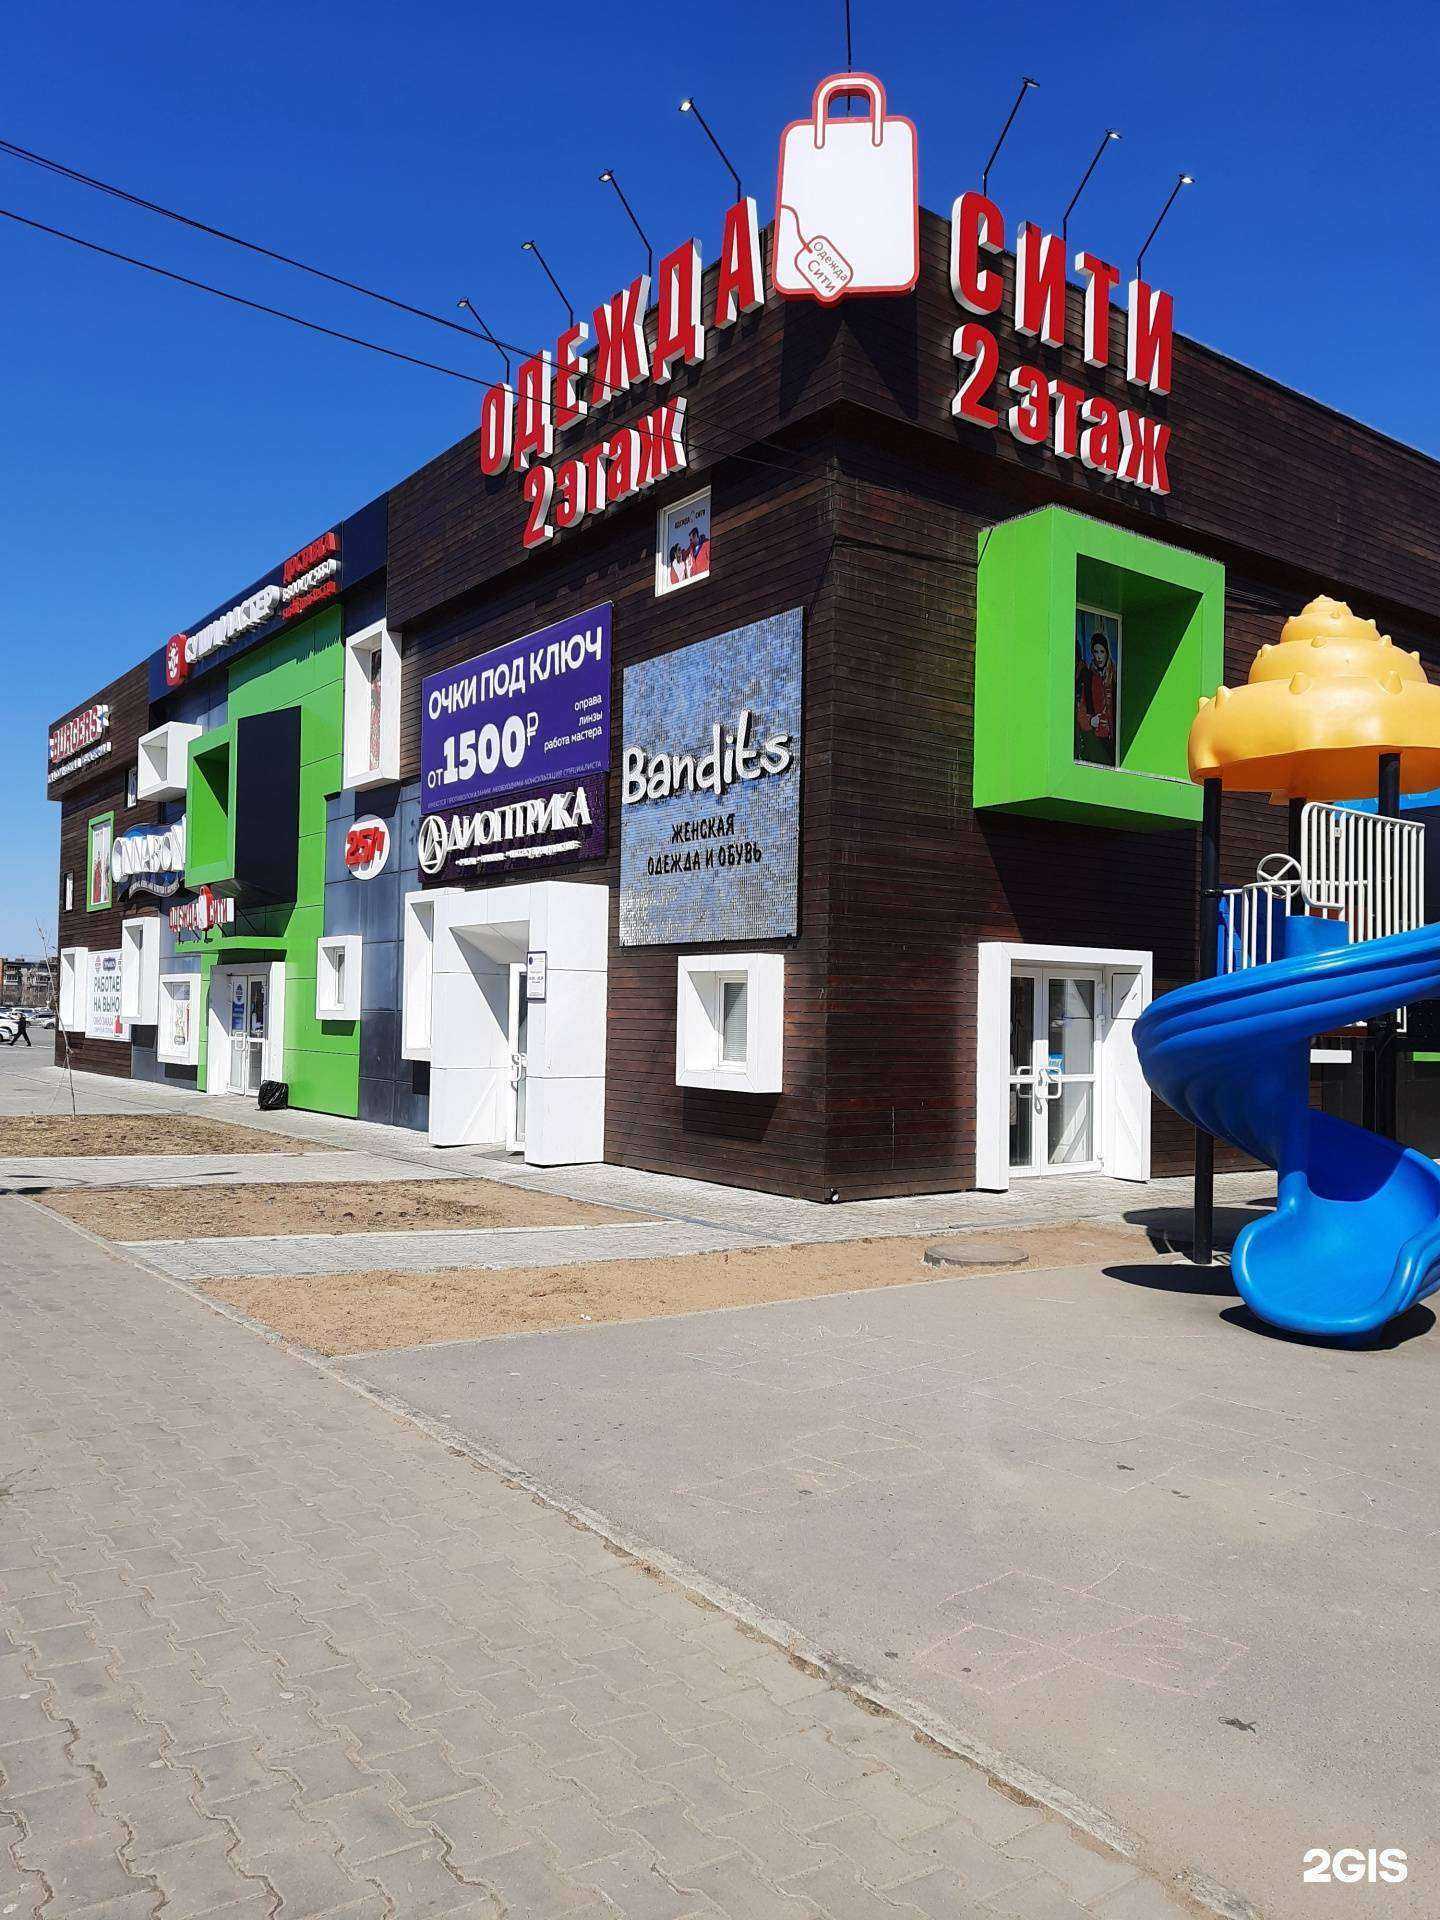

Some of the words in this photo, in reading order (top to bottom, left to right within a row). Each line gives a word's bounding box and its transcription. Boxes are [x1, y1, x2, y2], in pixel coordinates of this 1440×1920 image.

[808, 260, 836, 292] Сити
[814, 242, 848, 281] Одежда
[950, 191, 1173, 396] СИТИ
[480, 196, 764, 476] ОДЕЖДА
[428, 675, 477, 720] ОЧКИ
[480, 656, 526, 698] ПОД
[529, 626, 603, 684] КЛЮЧ
[574, 694, 603, 711] оправа
[578, 710, 603, 727] линзы
[544, 736, 570, 754] работа
[571, 726, 603, 743] мастера
[622, 709, 791, 804] Bandits
[671, 813, 735, 844] ЖЕНСКАЯ
[648, 850, 701, 875] ОДЕЖДА
[705, 847, 714, 868] И
[718, 841, 762, 866] ОБУВЬ
[93, 996, 102, 1012] НА
[103, 996, 120, 1012] ВЫНО
